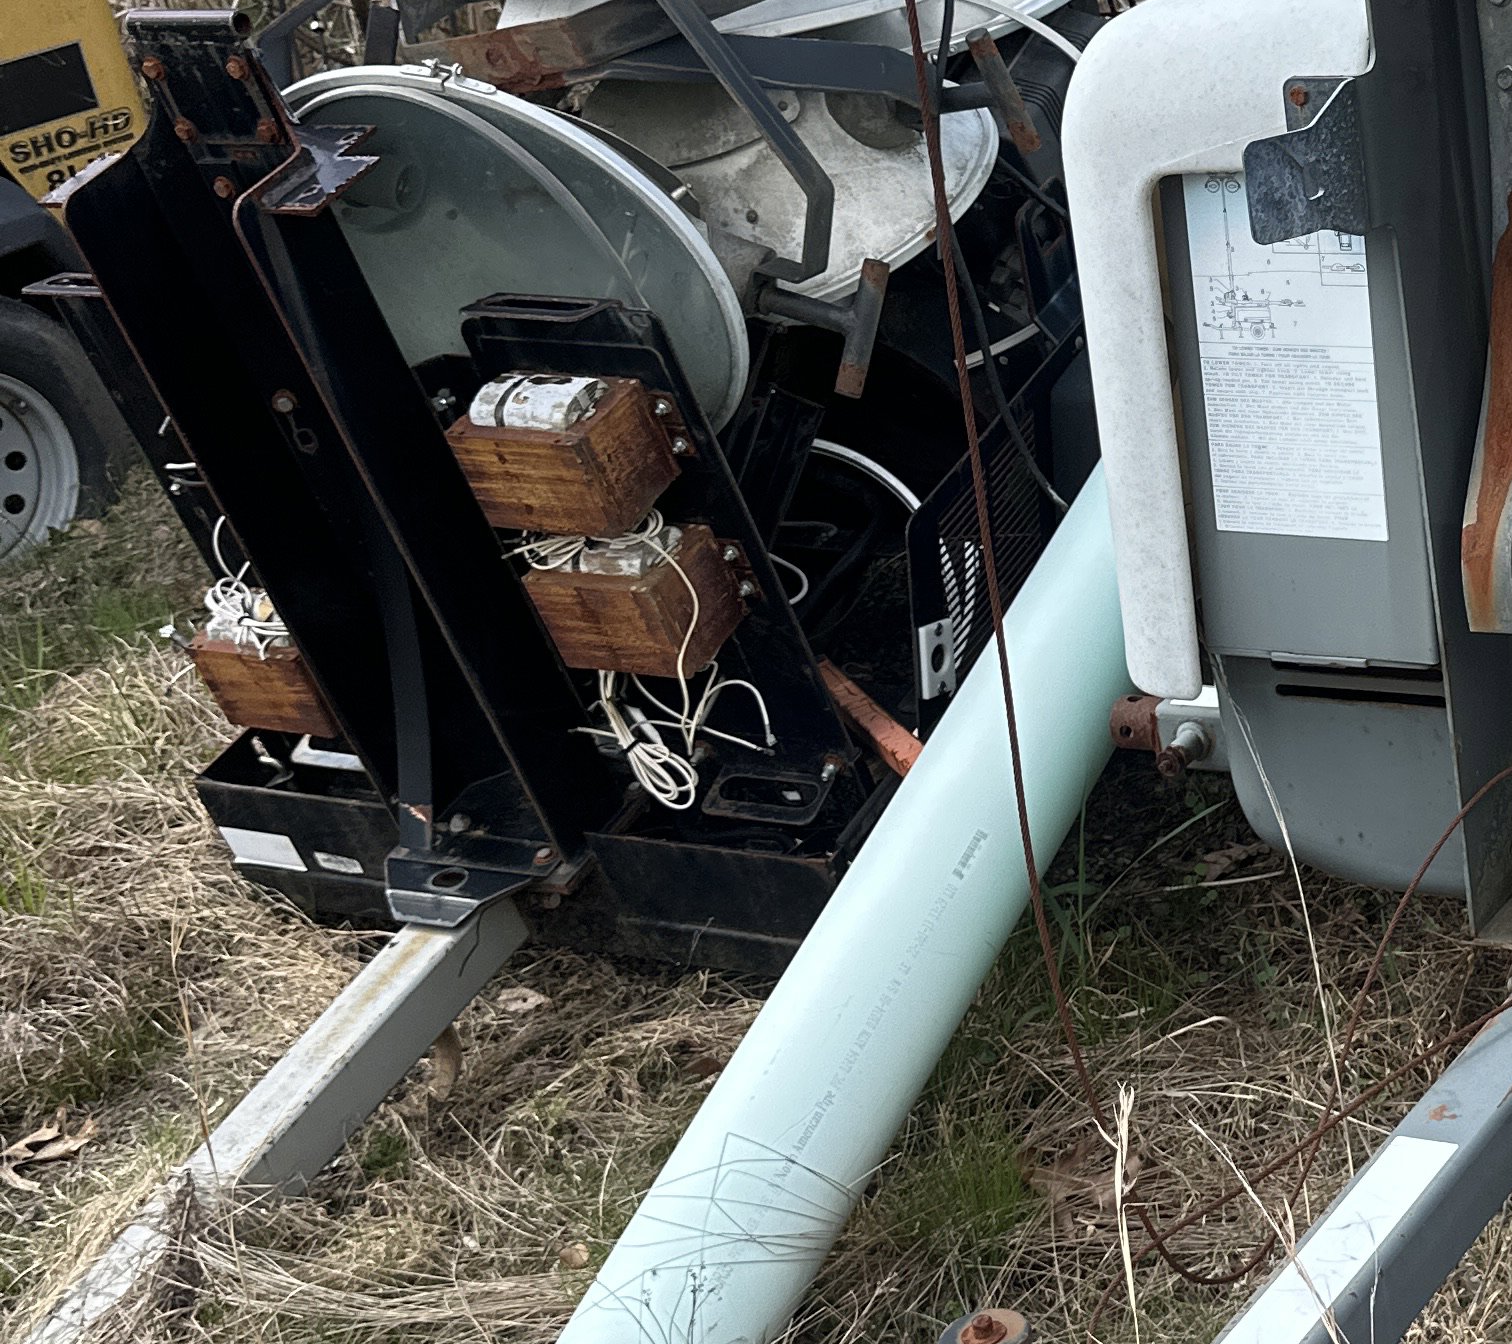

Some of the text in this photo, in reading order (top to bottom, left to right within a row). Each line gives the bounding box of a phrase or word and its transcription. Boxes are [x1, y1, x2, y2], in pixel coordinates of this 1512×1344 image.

[9, 106, 133, 164] SHO-HD
[792, 1108, 824, 1154] American
[813, 1086, 839, 1114] Pipe
